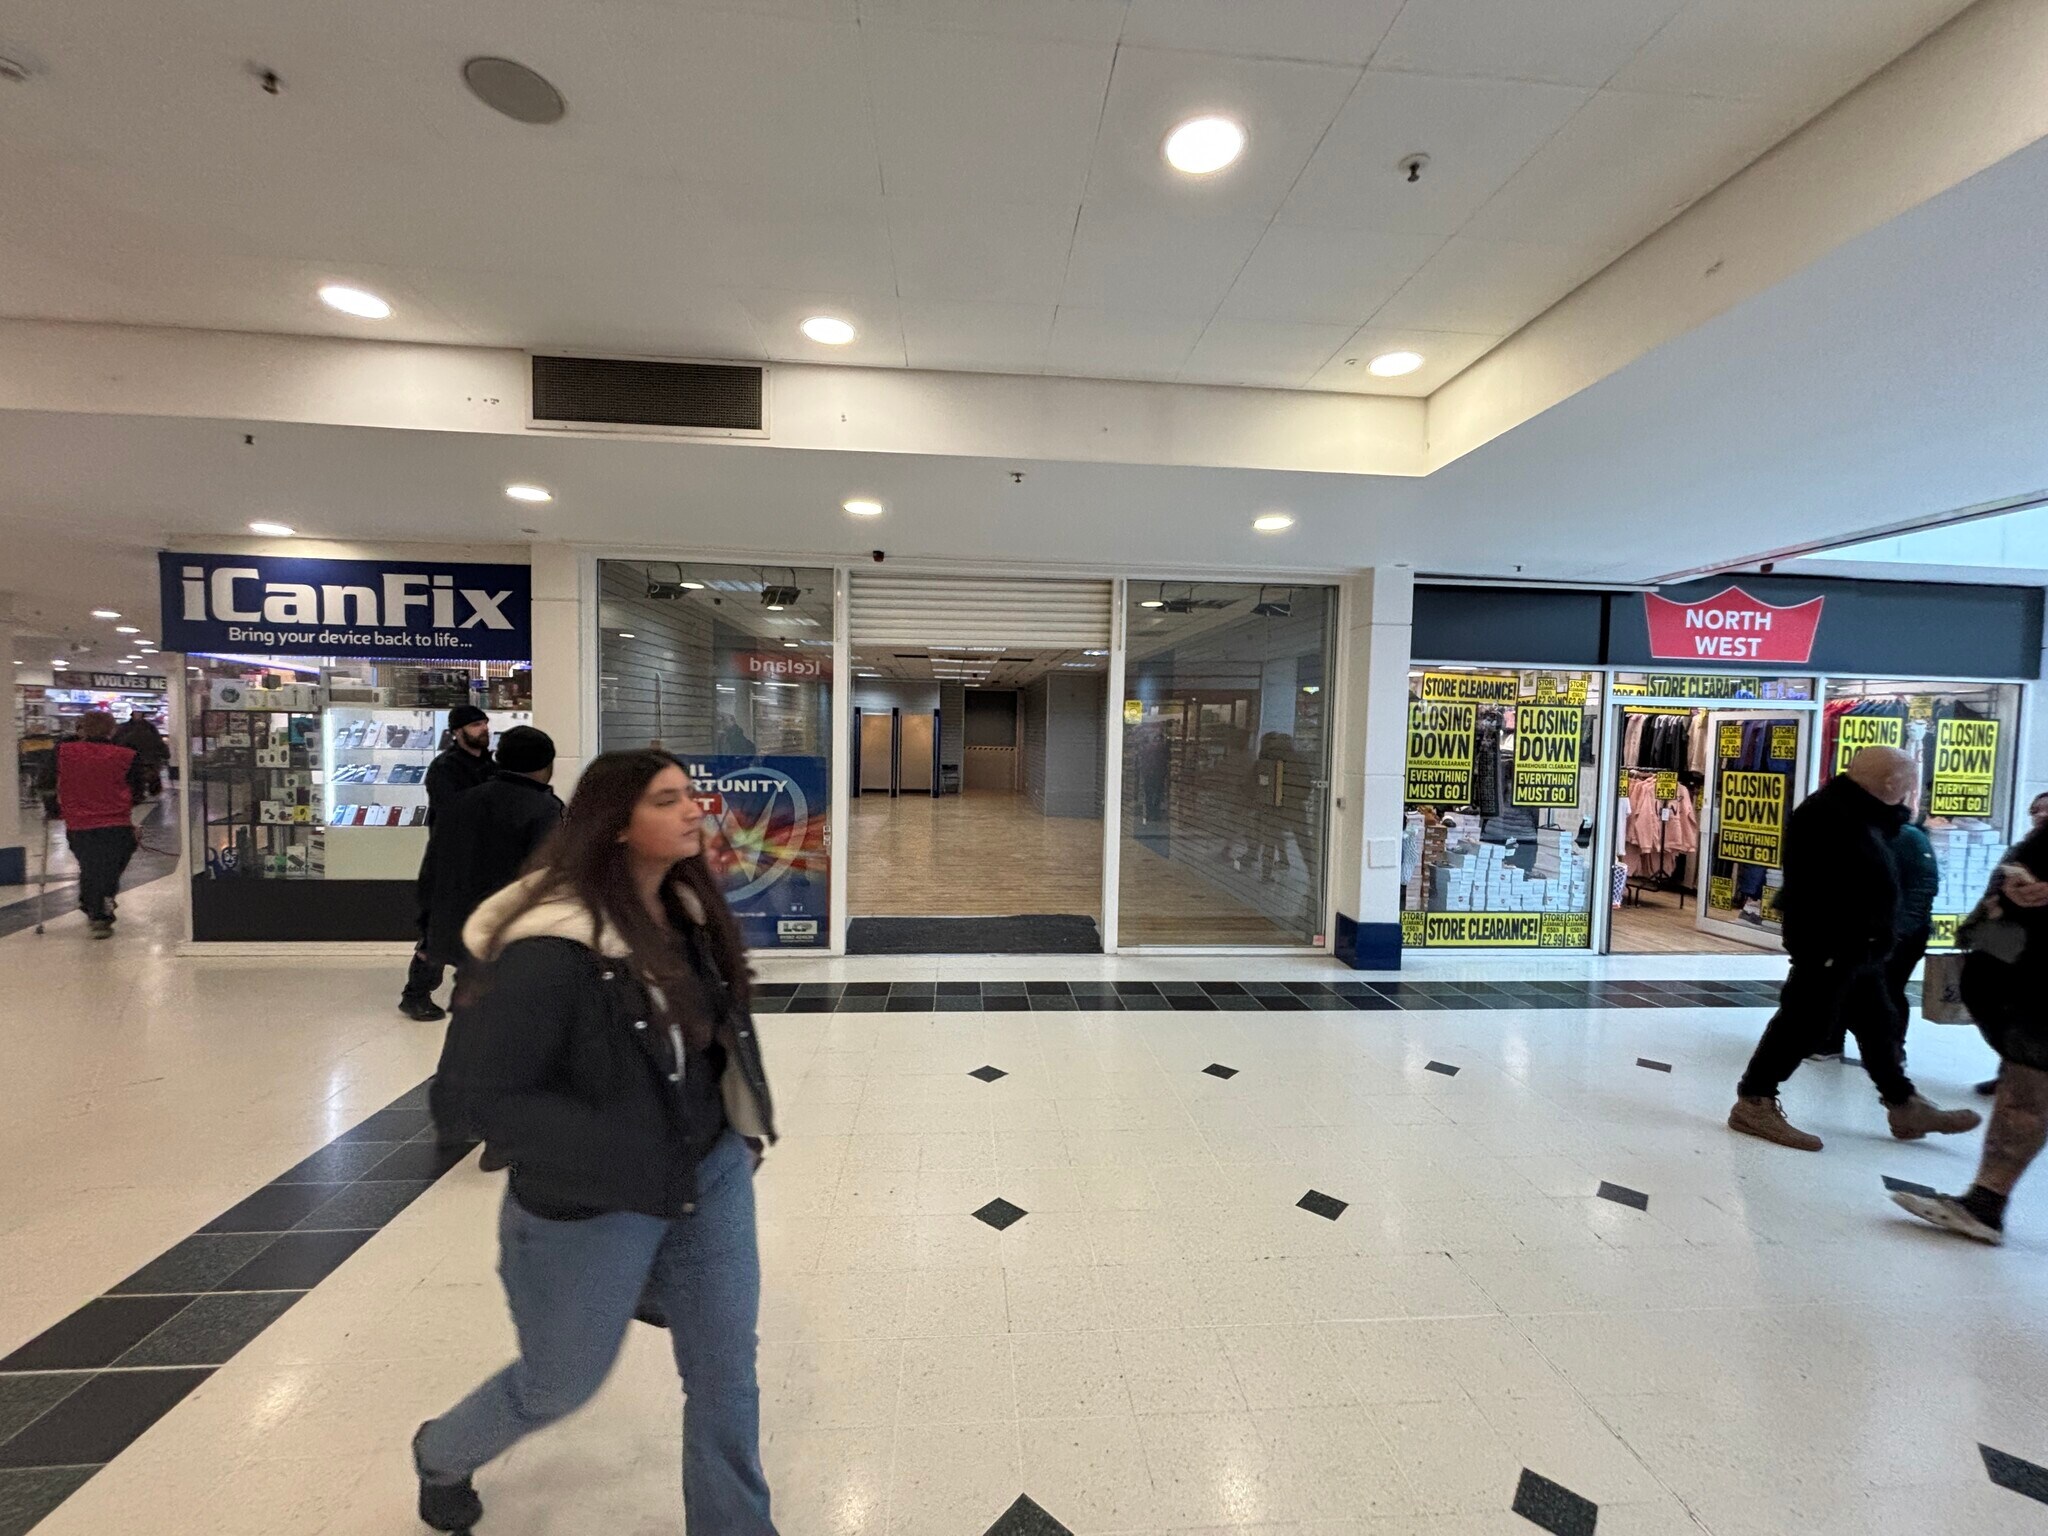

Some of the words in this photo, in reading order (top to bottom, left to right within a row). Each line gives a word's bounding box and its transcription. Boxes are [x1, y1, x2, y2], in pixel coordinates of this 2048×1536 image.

[182, 566, 516, 631] iCanFix
[1685, 609, 1772, 631] NORTH
[228, 626, 275, 646] Bring
[277, 631, 316, 647] your
[318, 629, 371, 646] device
[374, 630, 412, 647] back
[415, 633, 432, 647] to
[434, 632, 473, 649] life...
[1695, 635, 1762, 657] WEST
[93, 674, 148, 689] WOLVES
[1424, 677, 1457, 698] STORE
[1458, 679, 1518, 701] CLEARANCE!
[1538, 679, 1556, 687] STORE
[1649, 677, 1686, 698] STORE
[1688, 678, 1760, 699] CLEARANCE!
[1411, 703, 1473, 732] CLOSING
[1520, 708, 1578, 735] CLOSING
[1721, 727, 1740, 735] STORE
[1774, 726, 1796, 735] STORE
[1842, 719, 1899, 745] CLOSING
[1940, 722, 1995, 748] CLOSING
[1410, 733, 1470, 759] DOWN
[1519, 736, 1575, 762] DOWN
[1408, 759, 1441, 767] WAREHOUSE
[1441, 760, 1471, 768] CLEARANCE
[1516, 762, 1548, 770] WAREHOUSE
[1938, 748, 1992, 774] DOWN
[1410, 769, 1468, 784] EVERYTHING
[1518, 773, 1574, 787] EVERYTHING
[1658, 772, 1677, 780] STORE
[1408, 784, 1442, 799] MUST
[1444, 784, 1460, 800] GO
[1517, 787, 1549, 801] MUST
[1551, 788, 1566, 802] GO
[1656, 788, 1676, 799] £3.99
[1725, 773, 1782, 801] CLOSING
[1936, 783, 1989, 796] EVERYTHING
[1935, 796, 1966, 810] MUST
[1966, 797, 1982, 811] GO
[1724, 797, 1779, 826] DOWN
[1723, 830, 1778, 847] EVERYTHING
[1722, 843, 1753, 860] MUST
[1753, 847, 1770, 862] GO
[1402, 912, 1424, 921] STORE
[1543, 913, 1564, 922] STORE
[1566, 914, 1588, 922] STORE
[1428, 917, 1466, 941] STORE
[1468, 917, 1538, 941] CLEARANCE!
[1402, 932, 1423, 946] £2.99
[1541, 933, 1563, 946] £2.99
[1566, 933, 1588, 946] £4.99
